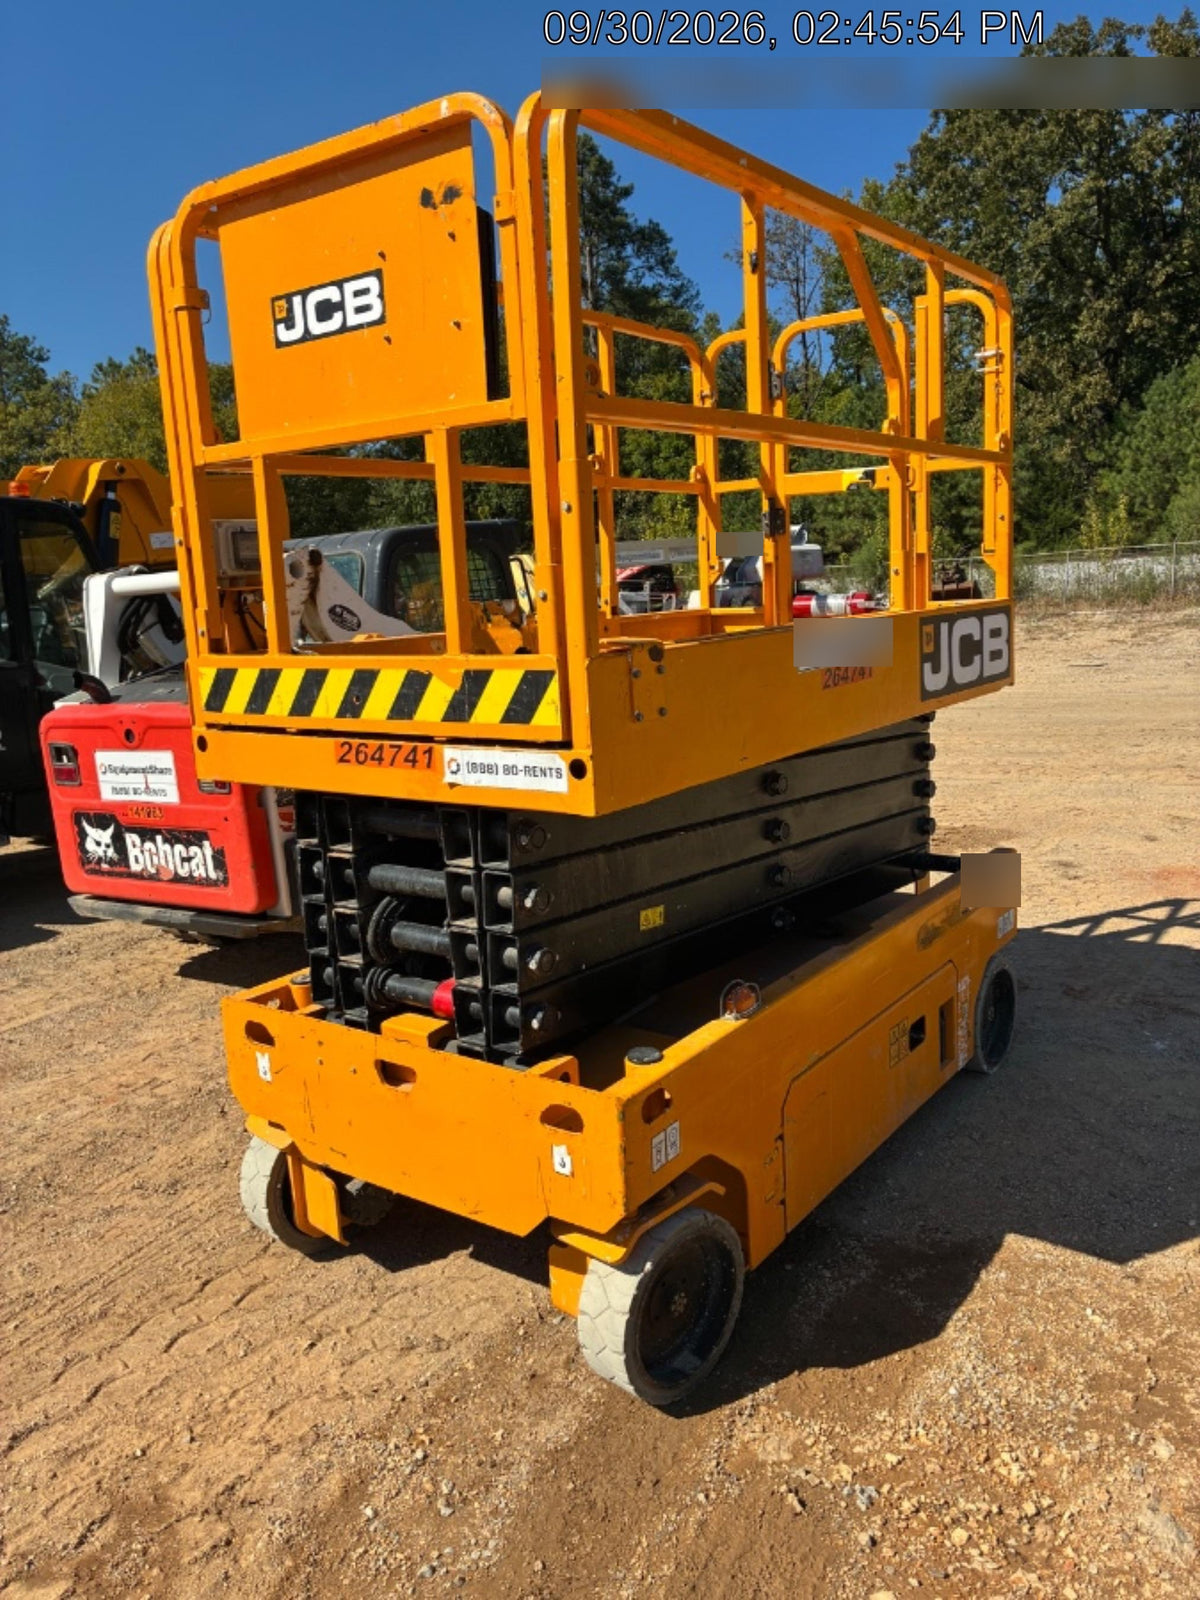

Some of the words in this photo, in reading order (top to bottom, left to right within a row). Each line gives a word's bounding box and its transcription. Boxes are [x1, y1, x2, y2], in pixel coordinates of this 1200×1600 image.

[276, 275, 384, 343] JCB
[922, 612, 1009, 692] JCB
[337, 740, 435, 769] 264741
[466, 760, 499, 776] (888)
[503, 763, 563, 780] 80-RENTS
[125, 832, 218, 880] Bobcat
